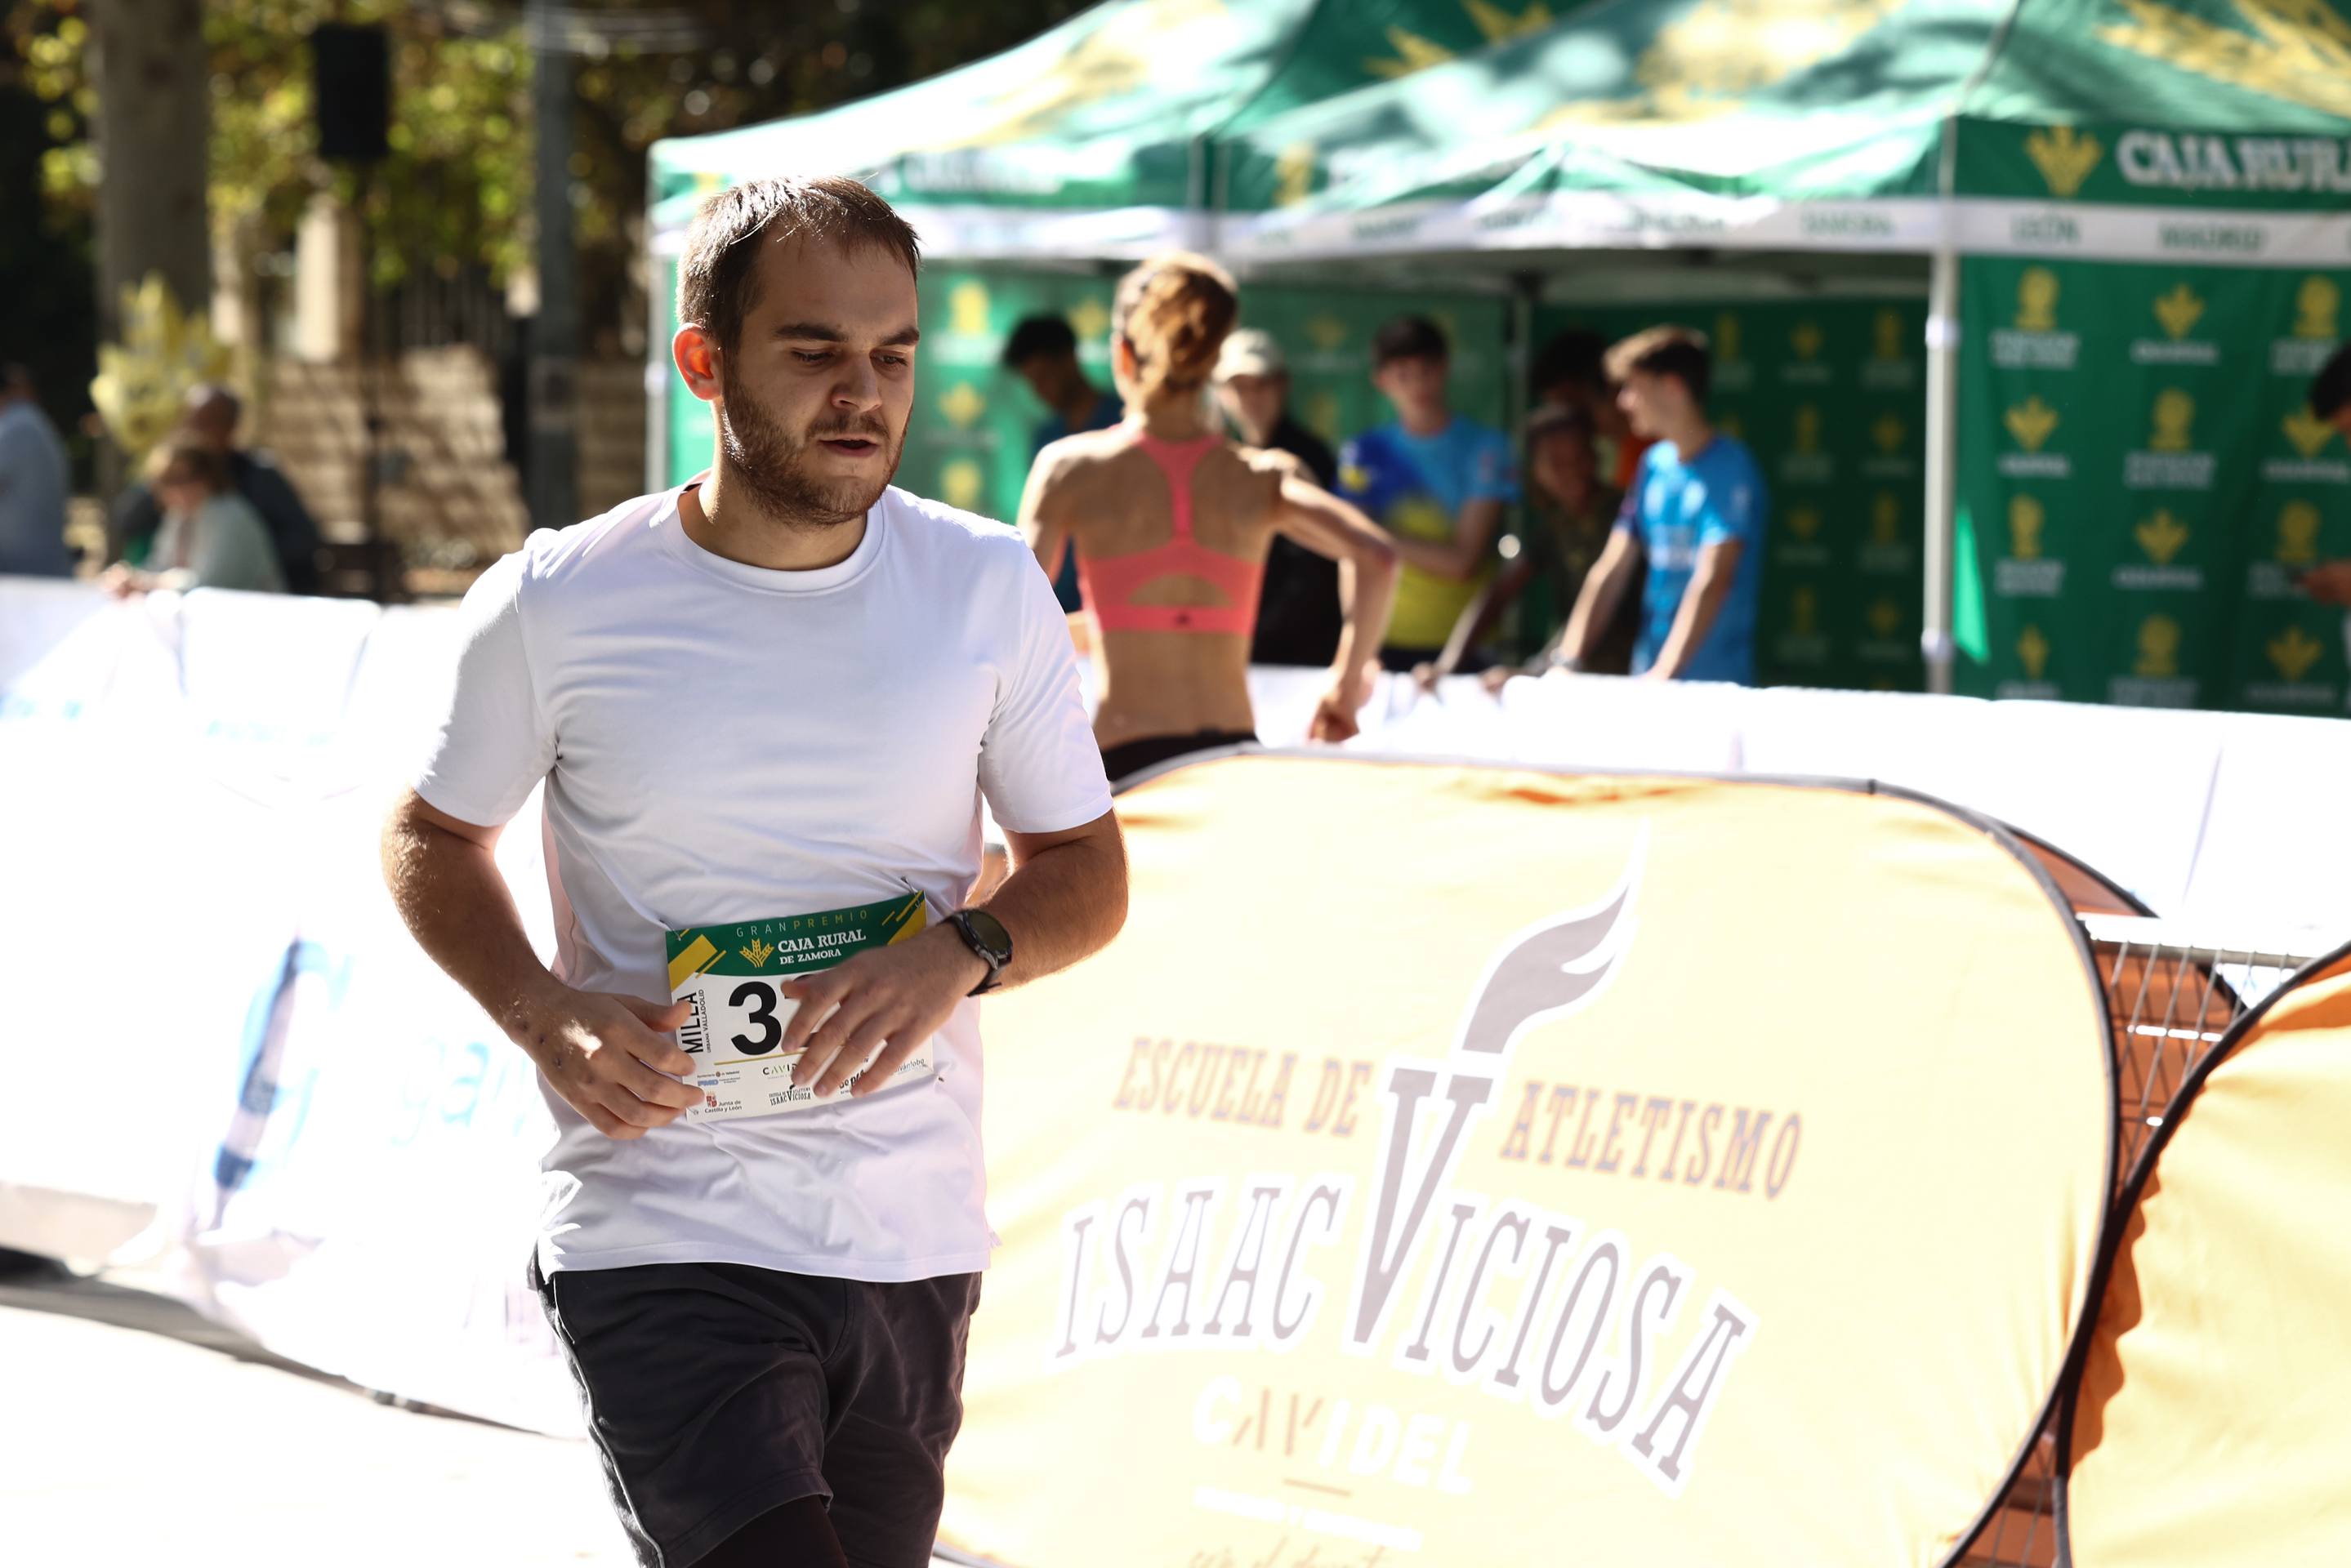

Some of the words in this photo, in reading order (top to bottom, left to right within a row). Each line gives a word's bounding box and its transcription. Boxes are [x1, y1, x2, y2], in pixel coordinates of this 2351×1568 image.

[2116, 129, 2238, 192] CAJA
[778, 938, 815, 953] CAJA
[818, 929, 867, 947] RURAL
[779, 956, 795, 964] DE
[797, 948, 842, 963] ZAMORA
[677, 991, 703, 1054] MILLA
[698, 989, 708, 1031] VALLADOLID
[770, 1095, 787, 1106] ISAAC
[787, 1090, 811, 1101] VICIOSA
[1113, 1036, 1297, 1129] ESCUELA
[1303, 1057, 1374, 1138] DE
[1498, 1079, 1803, 1202] ATLETISMO
[1055, 1184, 1341, 1358] ISAAC
[1354, 1067, 1747, 1481] VICIOSA
[1192, 1375, 1472, 1494] CAVIDEL
